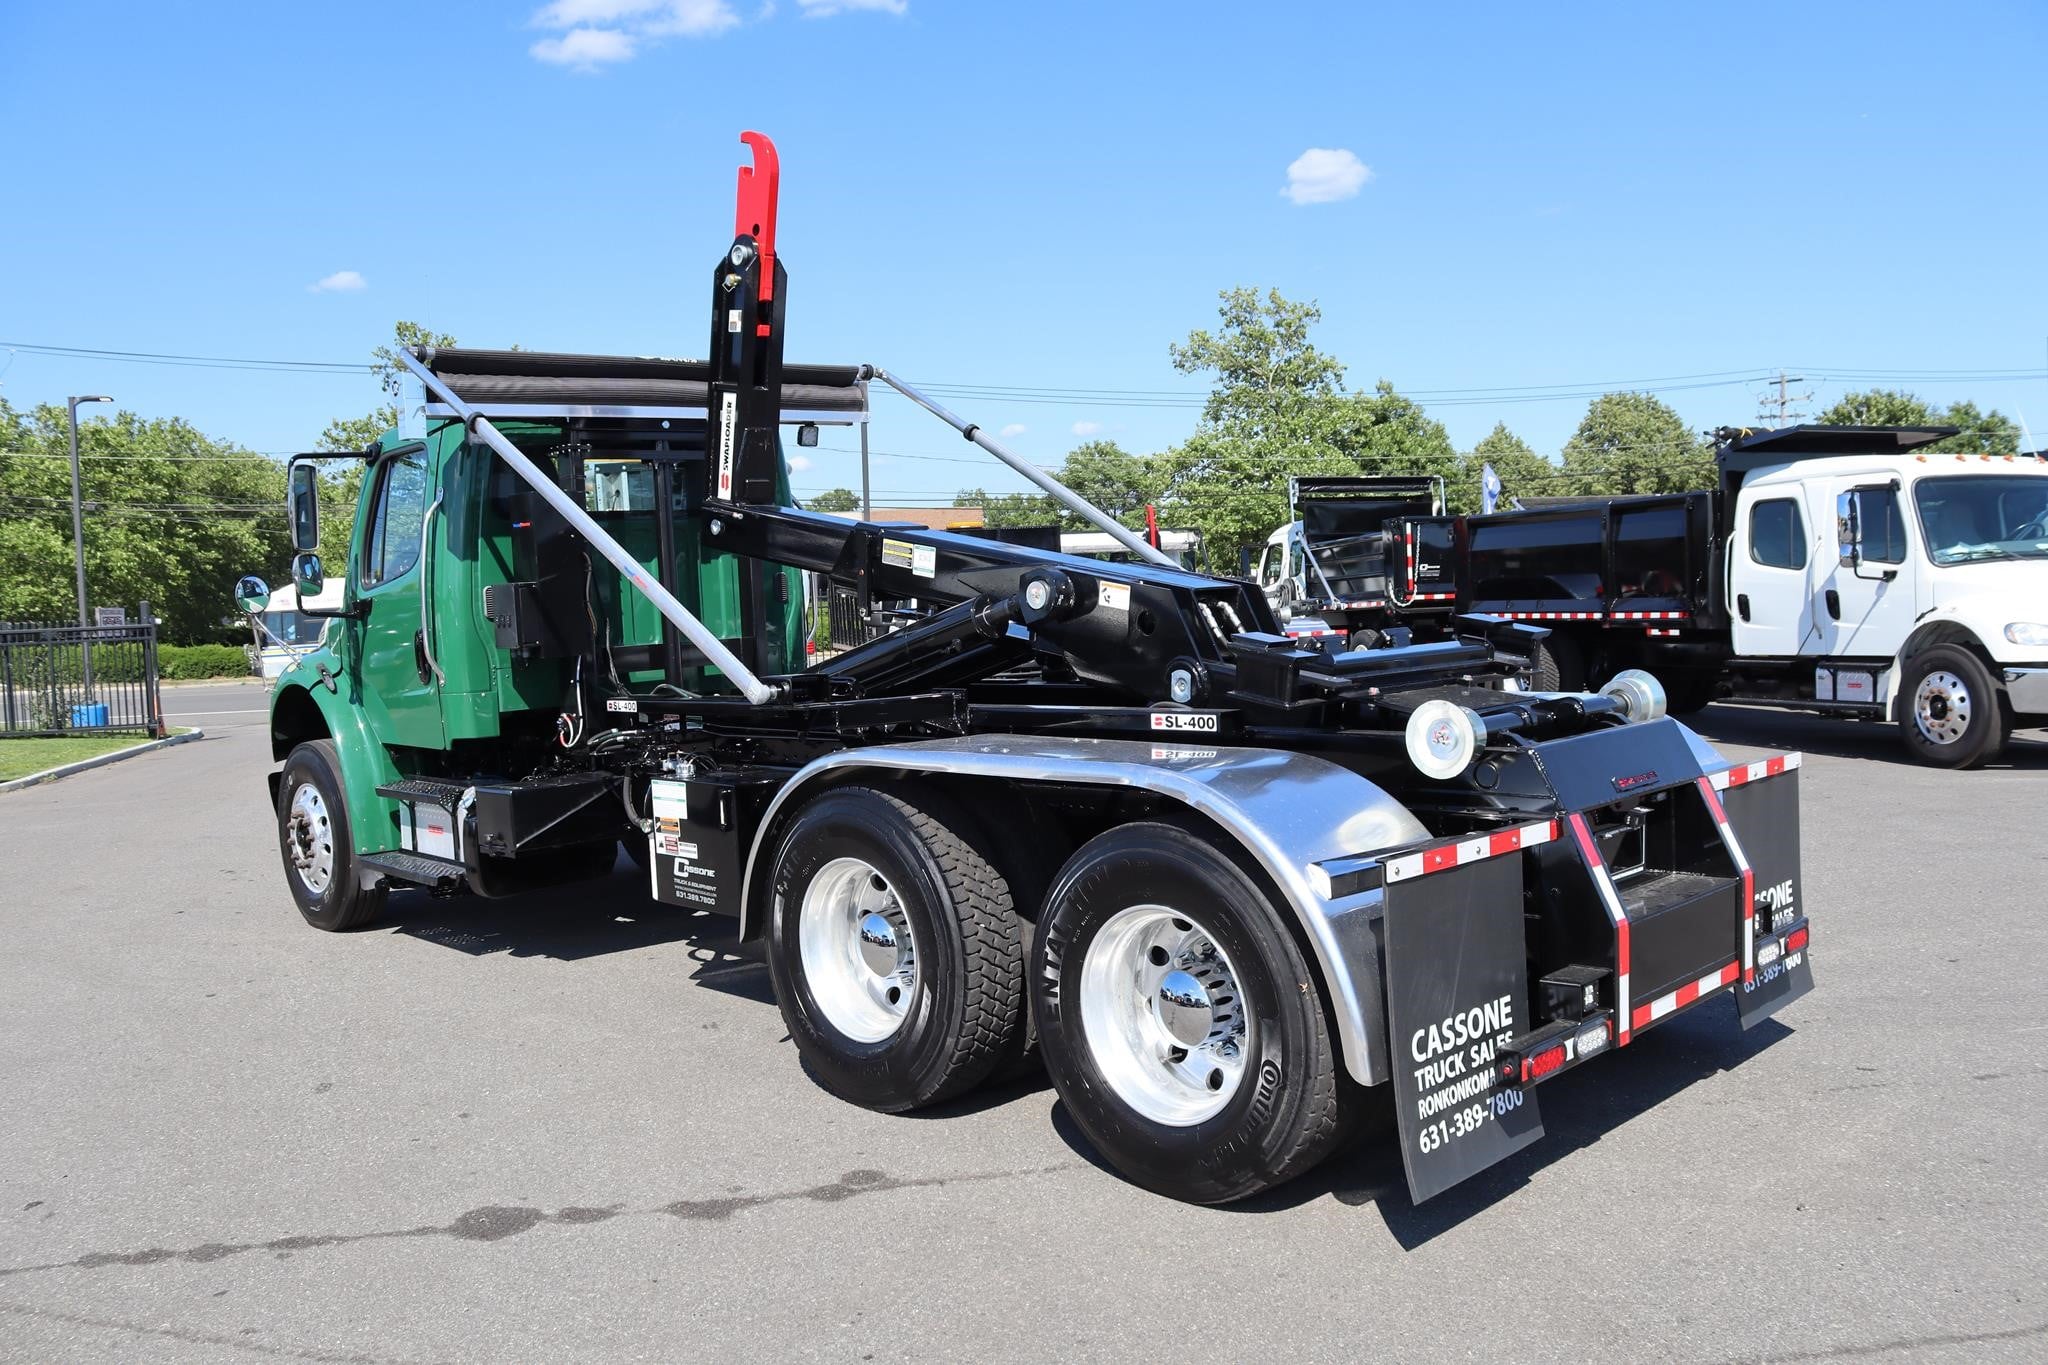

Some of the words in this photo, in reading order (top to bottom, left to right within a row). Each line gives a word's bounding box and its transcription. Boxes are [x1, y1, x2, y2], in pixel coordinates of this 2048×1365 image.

[723, 401, 733, 471] SWAPLOADER
[613, 701, 637, 711] SL-400
[1165, 715, 1216, 730] SL-400
[1411, 994, 1513, 1063] CASSONE
[1414, 1054, 1467, 1092] TRUCK
[1471, 1031, 1514, 1069] SALES
[1418, 1067, 1497, 1120] RONKONKOMA
[1419, 1089, 1524, 1154] 631-389-7800
